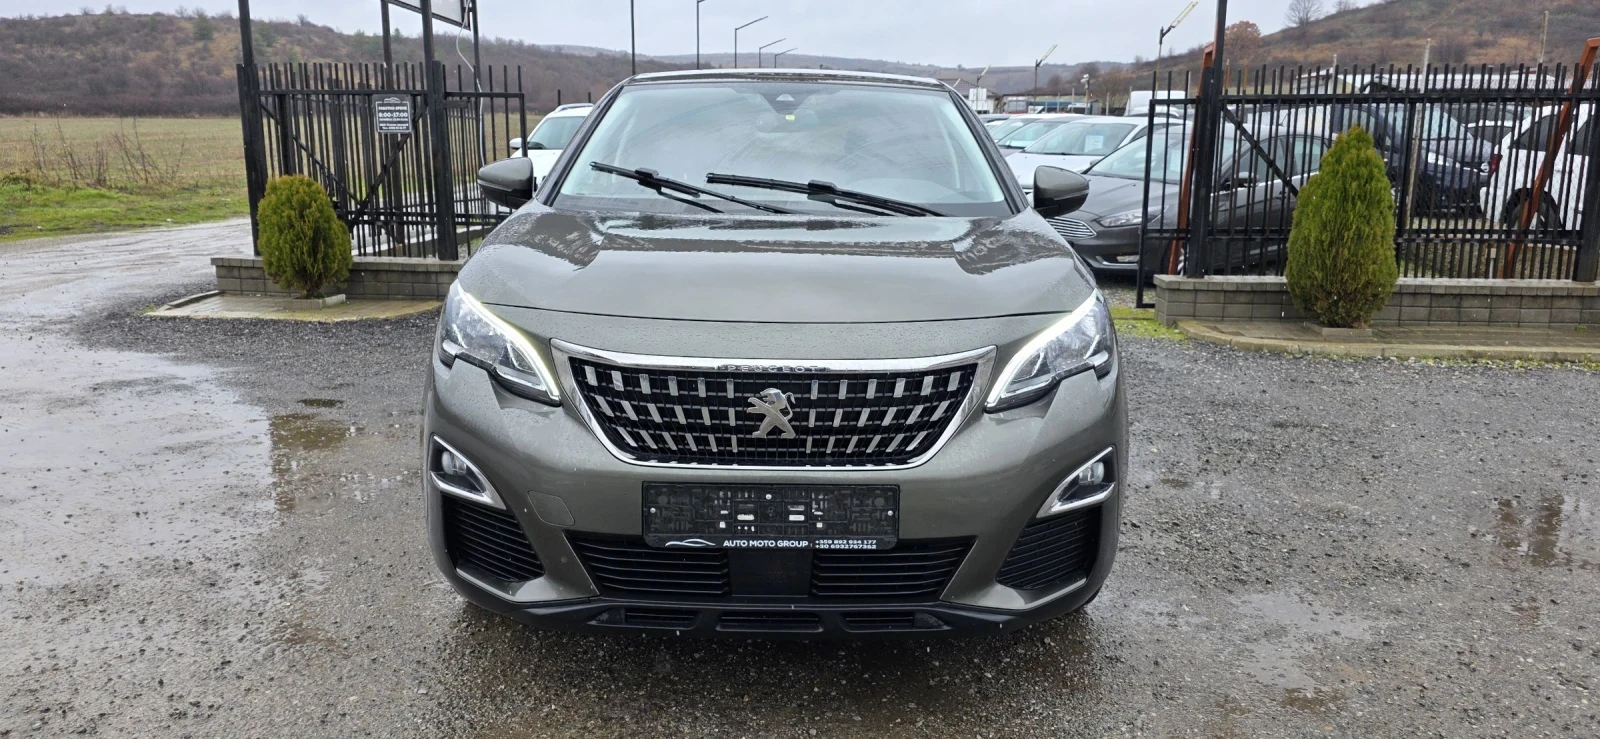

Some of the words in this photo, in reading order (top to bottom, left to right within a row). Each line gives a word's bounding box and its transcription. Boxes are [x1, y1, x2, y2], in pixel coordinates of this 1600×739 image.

[727, 364, 819, 373] PEUGEOT
[722, 539, 748, 548] AUTO
[749, 539, 776, 548] MOTO
[776, 540, 809, 548] GROUP
